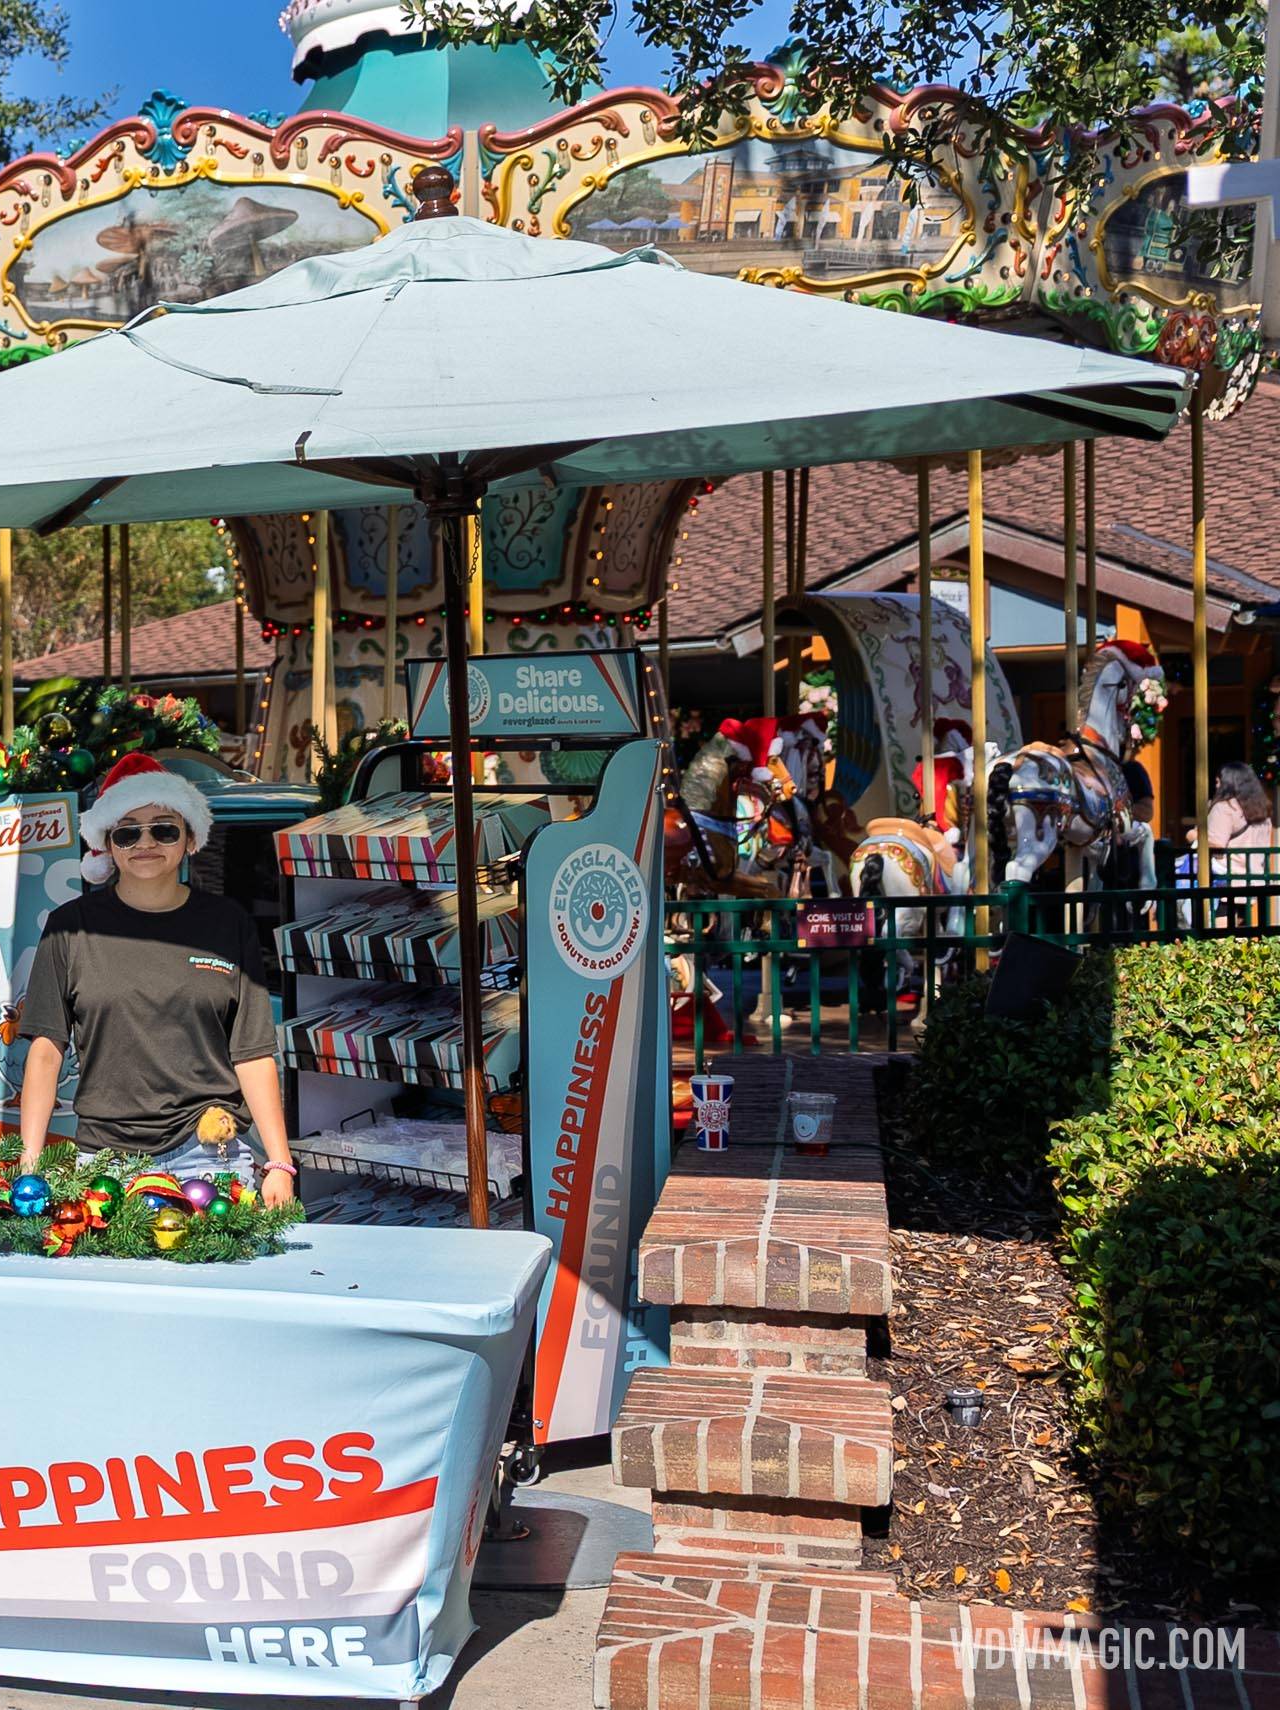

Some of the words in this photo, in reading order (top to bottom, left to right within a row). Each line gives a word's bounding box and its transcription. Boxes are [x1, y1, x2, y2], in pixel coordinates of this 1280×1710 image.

[516, 665, 582, 689] Share
[498, 689, 605, 714] Delicious.
[554, 850, 641, 911] EVERGLAZED
[807, 913, 830, 923] COME
[831, 912, 853, 921] VISIT
[854, 912, 865, 921] US
[810, 924, 820, 934] AT
[821, 924, 837, 933] THE
[840, 924, 863, 933] TRAIN
[557, 923, 589, 967] DONUTS
[589, 960, 598, 970] &
[598, 952, 623, 969] COLD
[622, 917, 640, 955] BREW
[545, 991, 609, 1220] HAPPINESS
[581, 1164, 623, 1350] FOUND
[90, 1549, 354, 1603] FOUND
[204, 1625, 374, 1669] HERE
